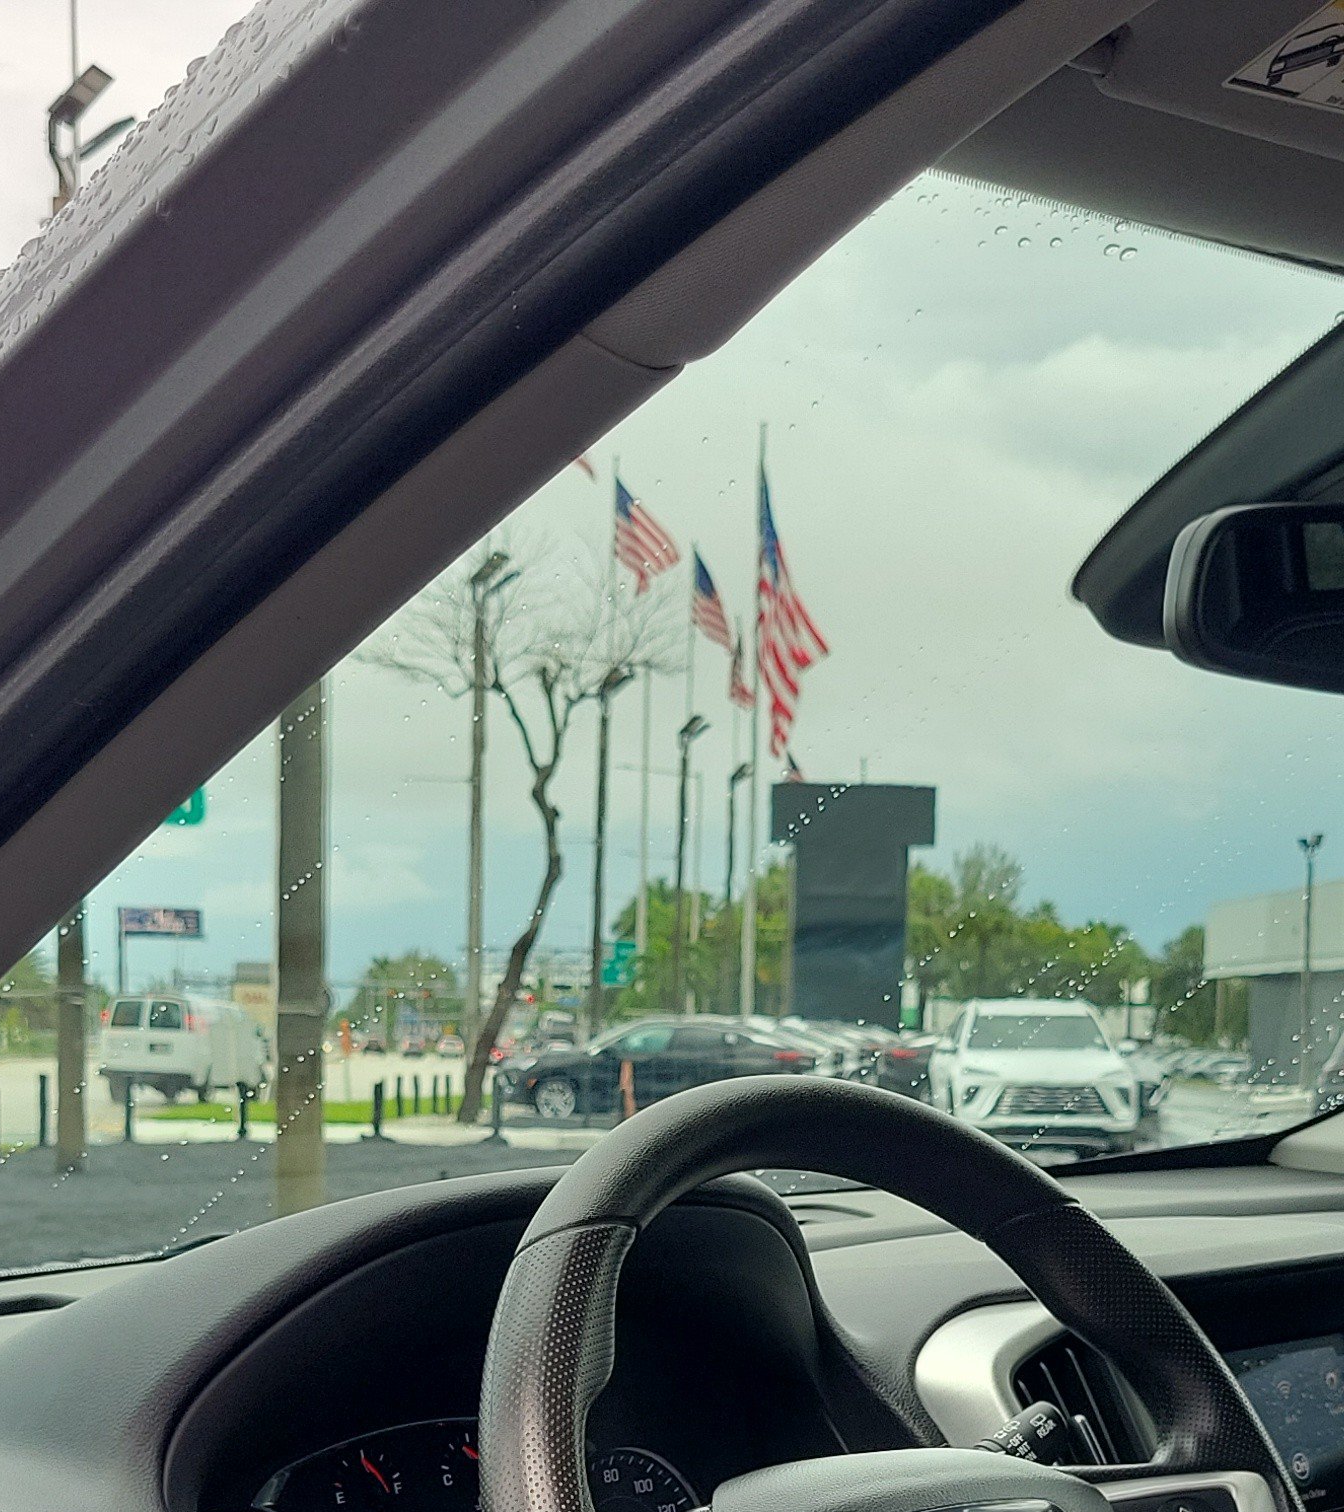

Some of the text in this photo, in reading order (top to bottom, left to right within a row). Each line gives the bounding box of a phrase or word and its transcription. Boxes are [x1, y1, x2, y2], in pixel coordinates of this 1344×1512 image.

[442, 1474, 454, 1487] C
[603, 1468, 619, 1483] 80
[393, 1482, 403, 1495] F
[633, 1478, 654, 1494] 100
[336, 1492, 345, 1505] E
